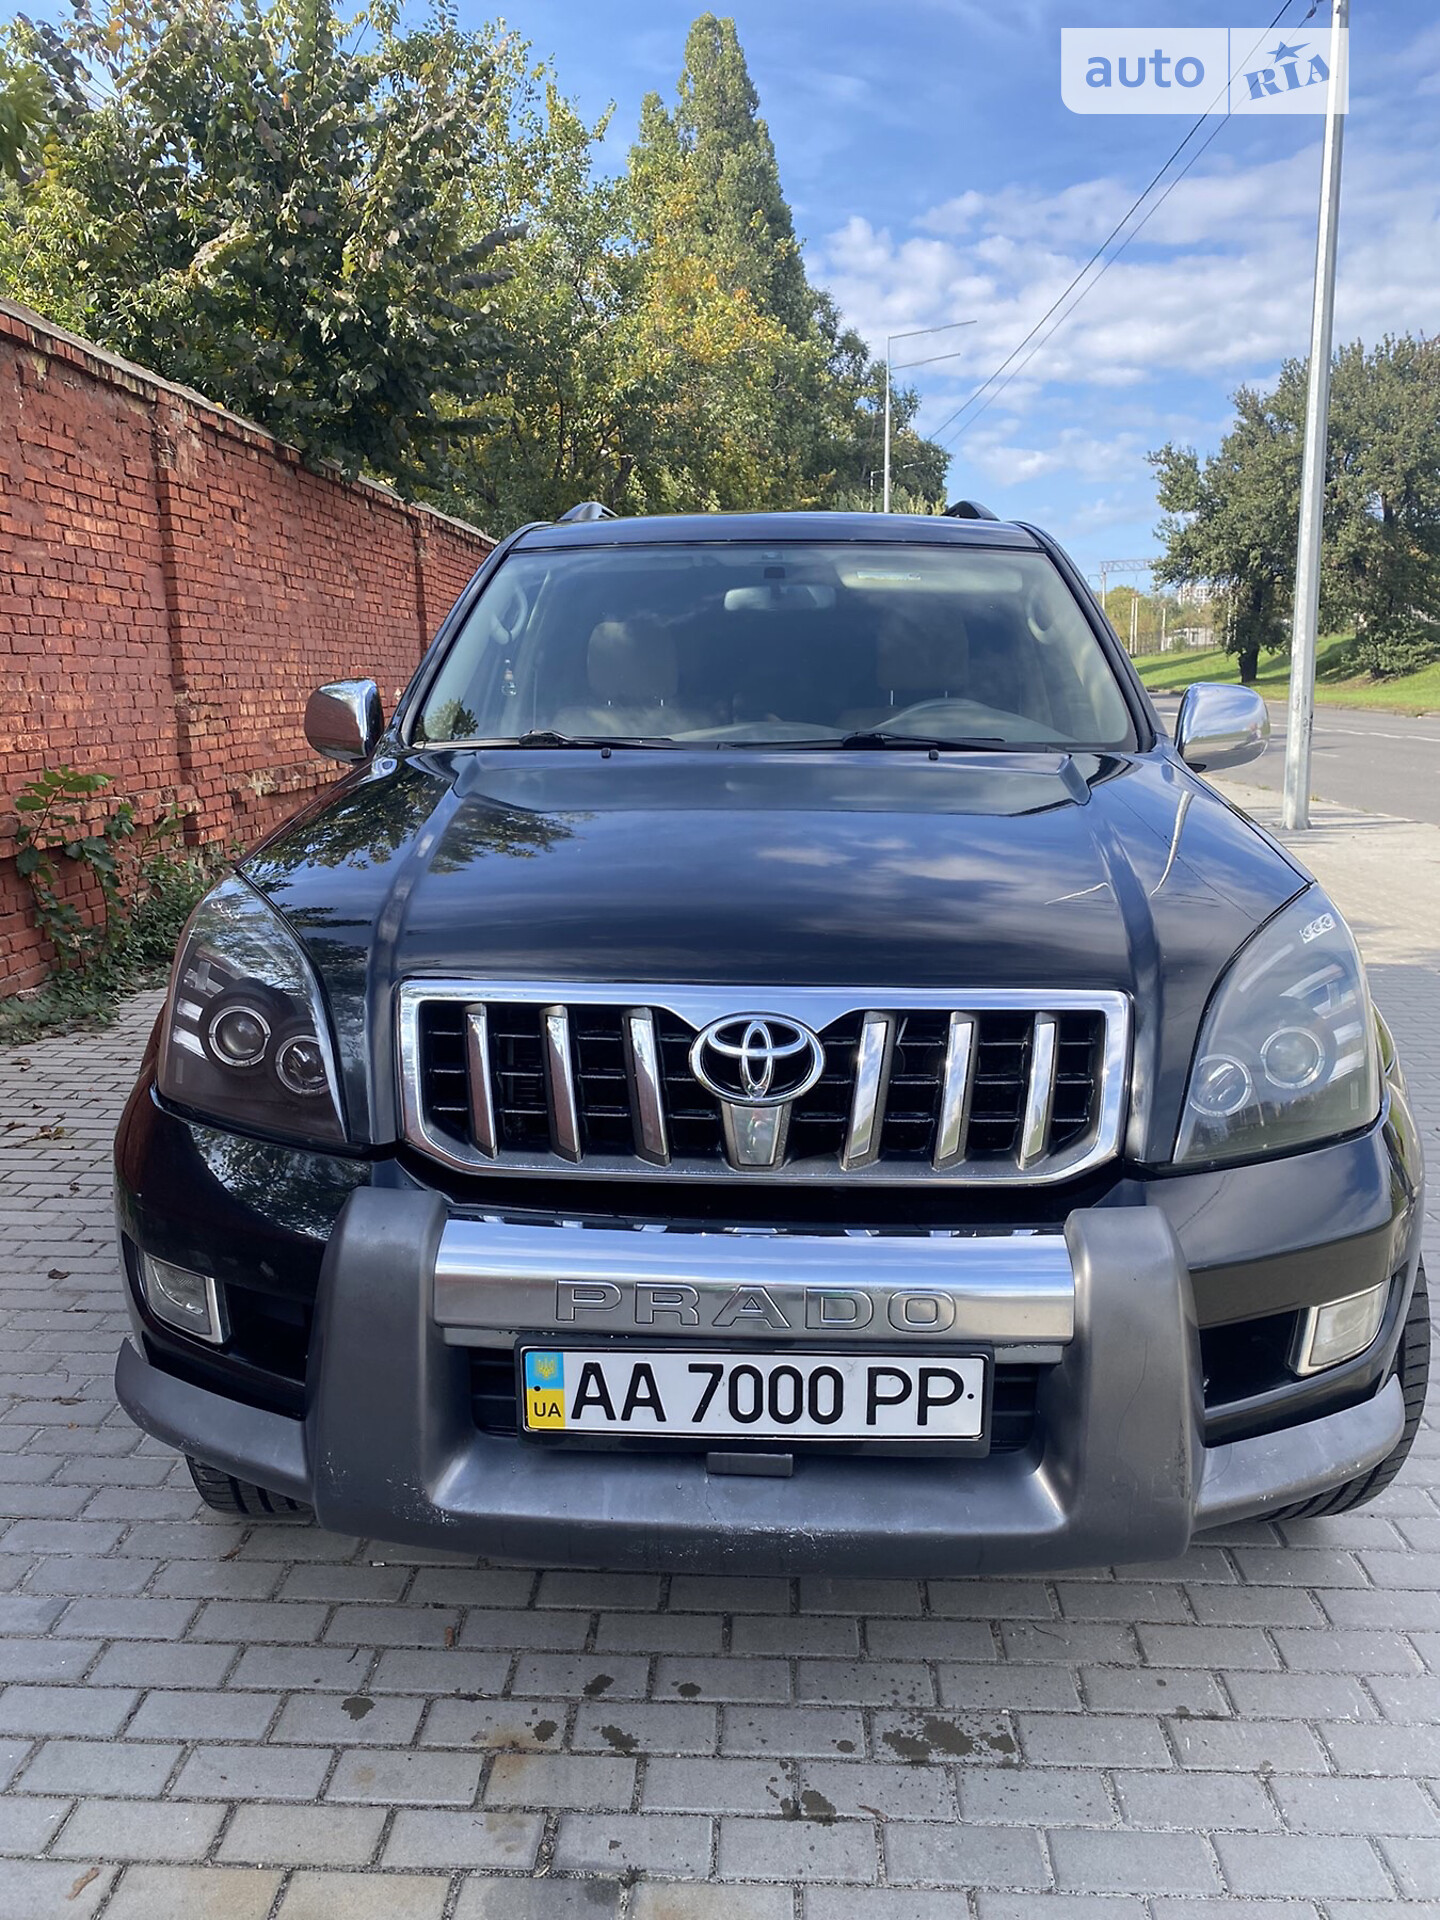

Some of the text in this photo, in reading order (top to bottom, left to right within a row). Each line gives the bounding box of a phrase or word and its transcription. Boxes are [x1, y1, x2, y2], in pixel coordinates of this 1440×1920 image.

[555, 1280, 957, 1333] PRADO
[533, 1401, 562, 1418] UA
[570, 1362, 964, 1426] AA 7000 PP
